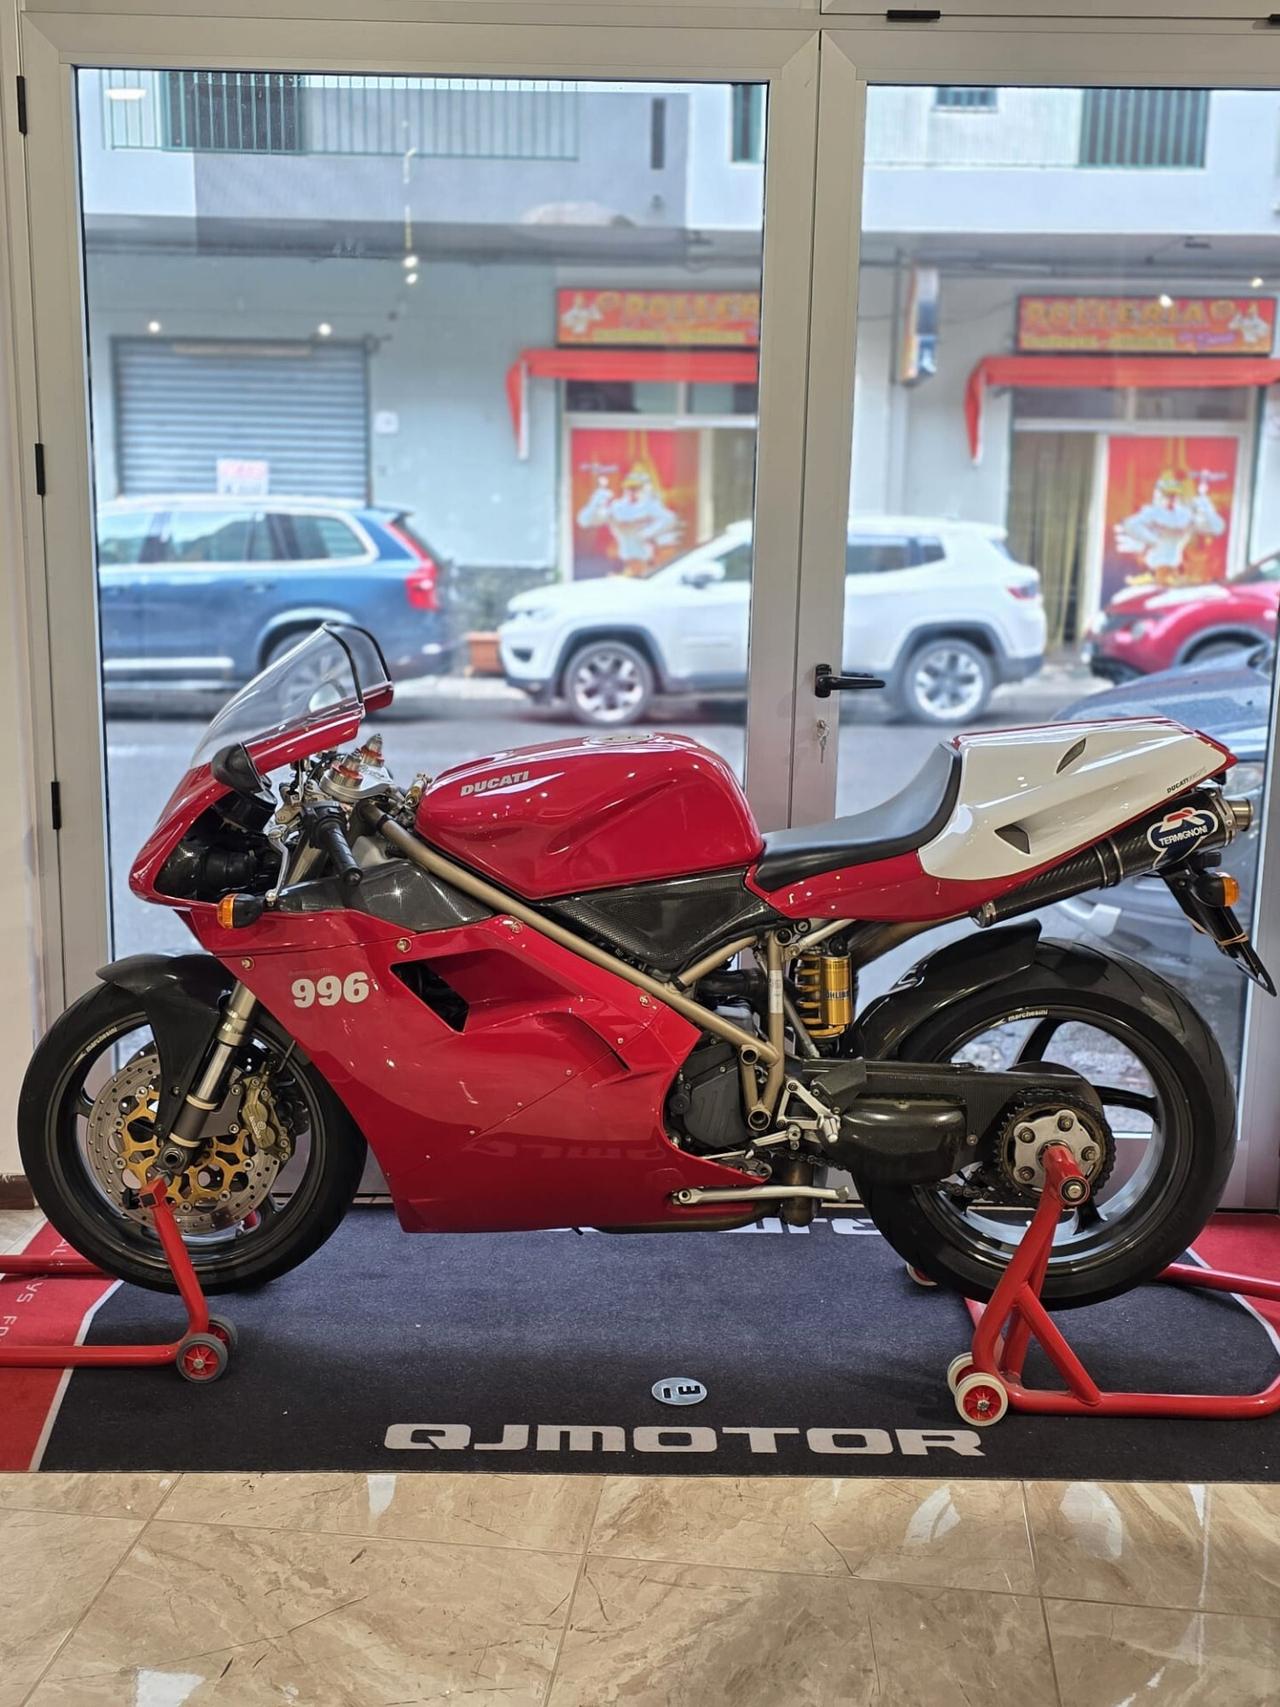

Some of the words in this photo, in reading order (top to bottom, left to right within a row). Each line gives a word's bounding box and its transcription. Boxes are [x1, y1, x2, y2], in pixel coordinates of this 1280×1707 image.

[460, 771, 529, 796] DUCATI
[1166, 777, 1190, 793] DUCATI
[1159, 825, 1208, 846] TERMIGNONI
[291, 971, 369, 1008] 996
[1008, 1009, 1048, 1022] marchesini
[384, 1423, 986, 1457] QJMOTOR
